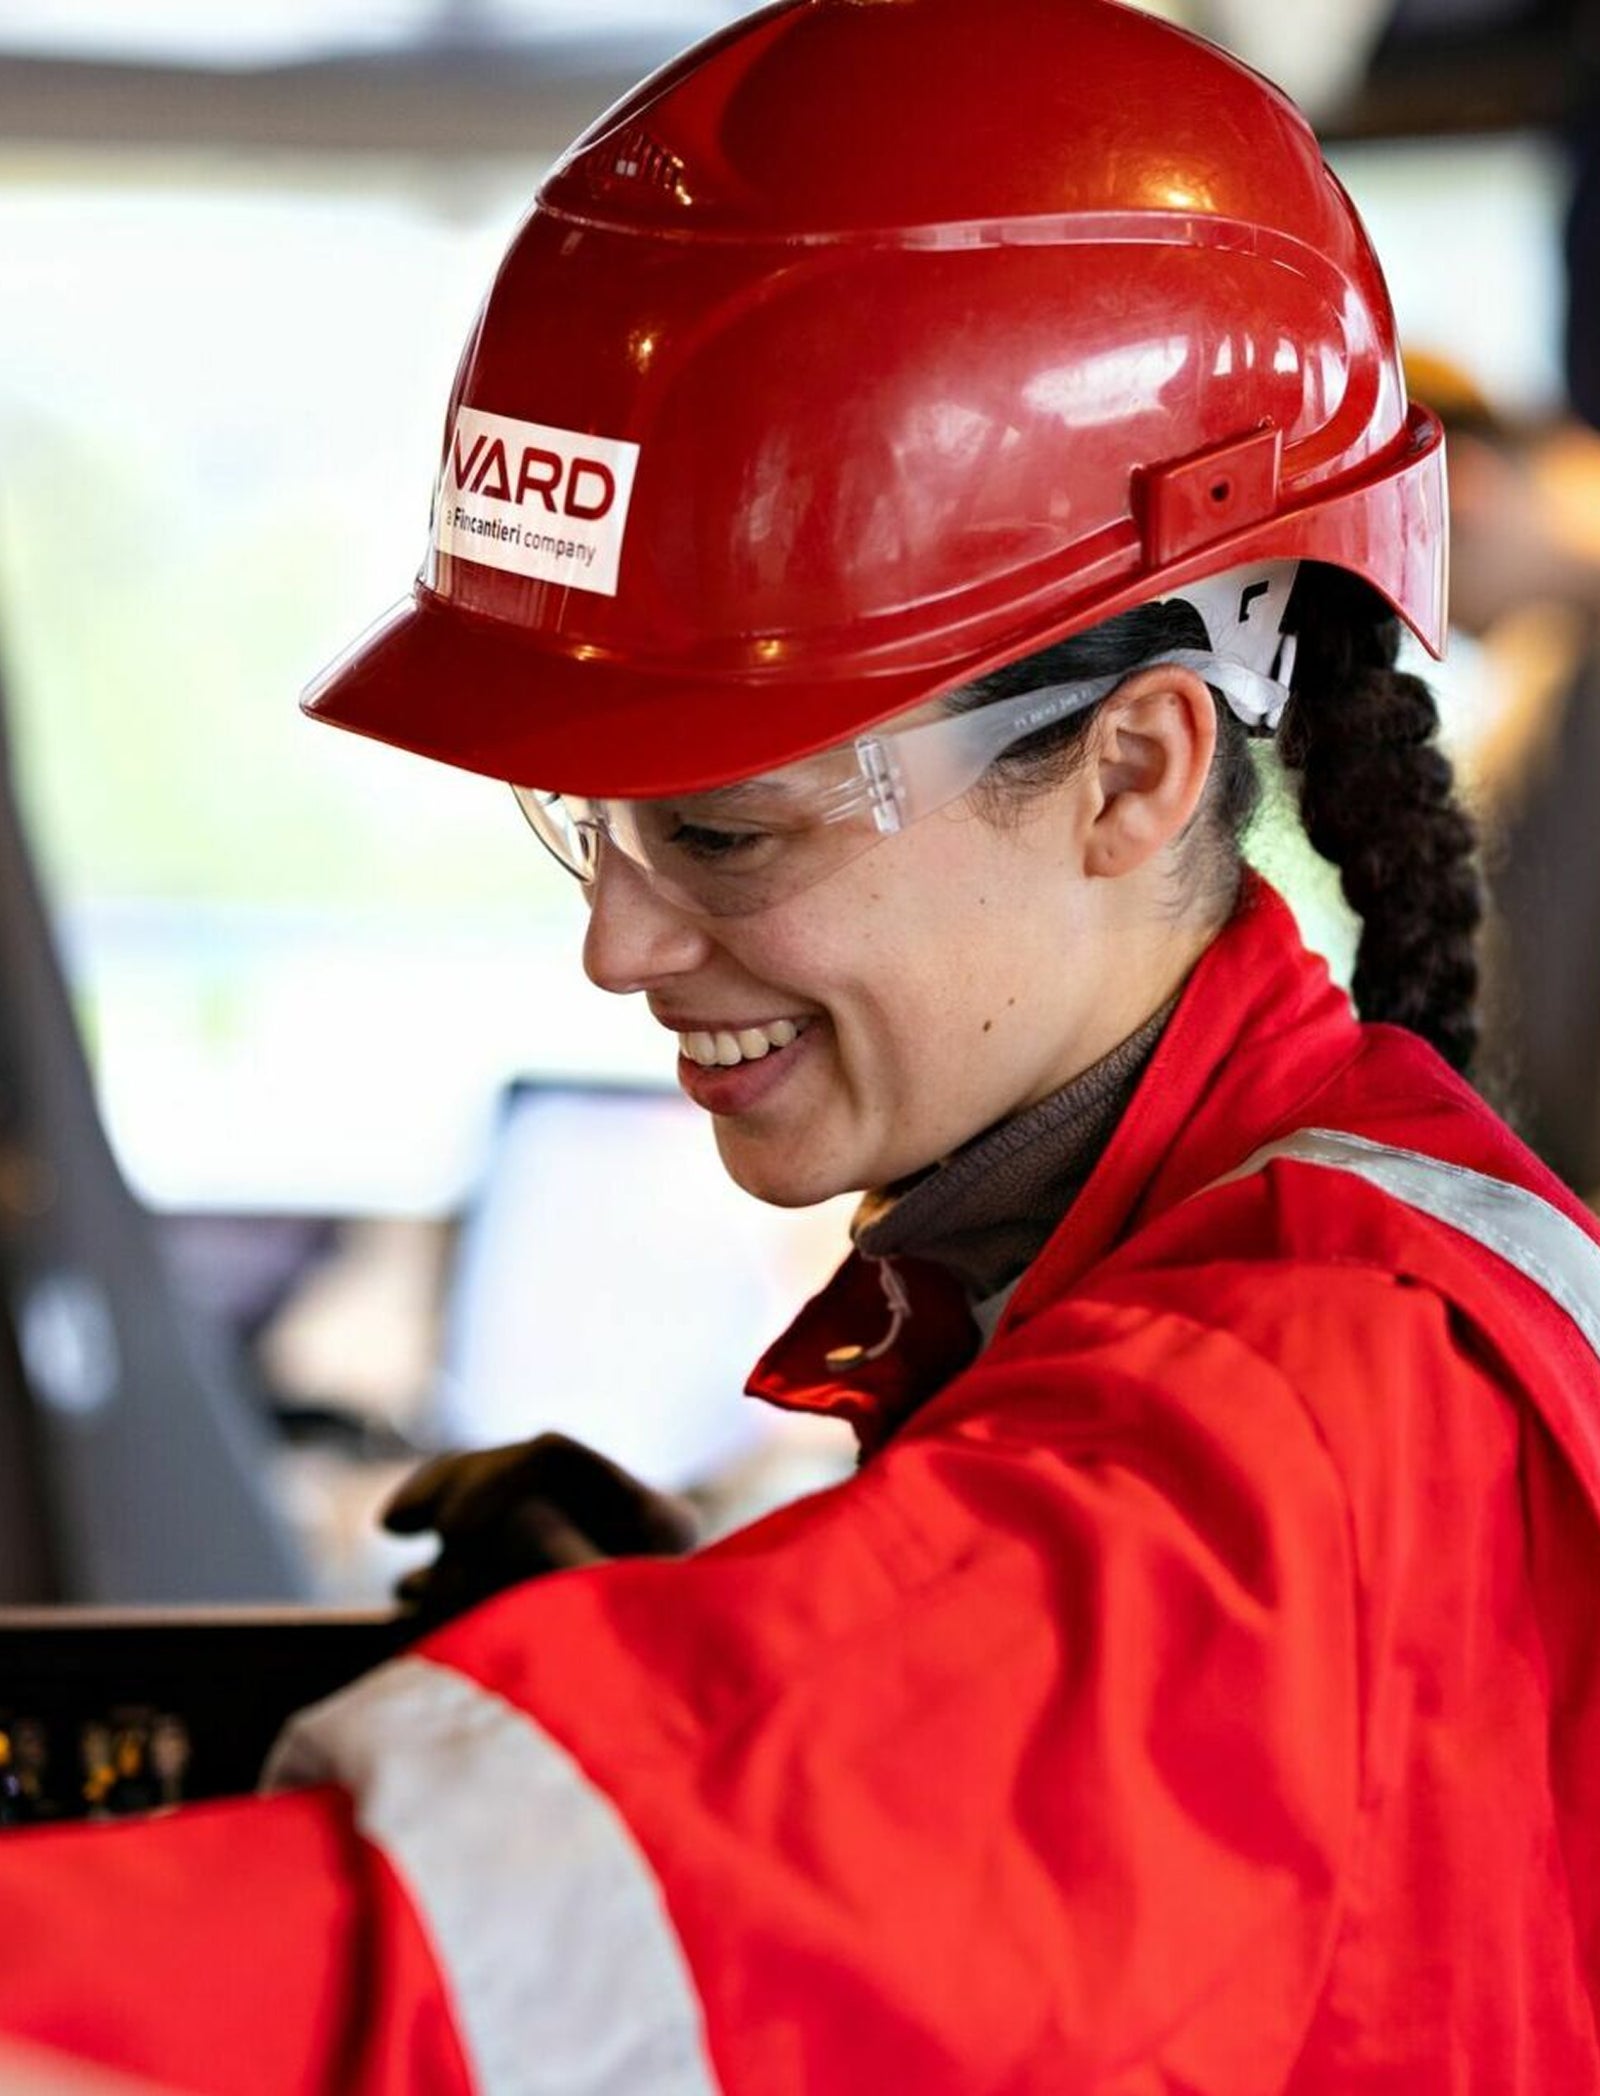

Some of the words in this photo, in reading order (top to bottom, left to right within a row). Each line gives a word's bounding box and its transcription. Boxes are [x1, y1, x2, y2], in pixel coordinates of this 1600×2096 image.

[454, 429, 616, 521] VARD
[453, 507, 521, 544] Fincantieri
[524, 530, 596, 567] company
